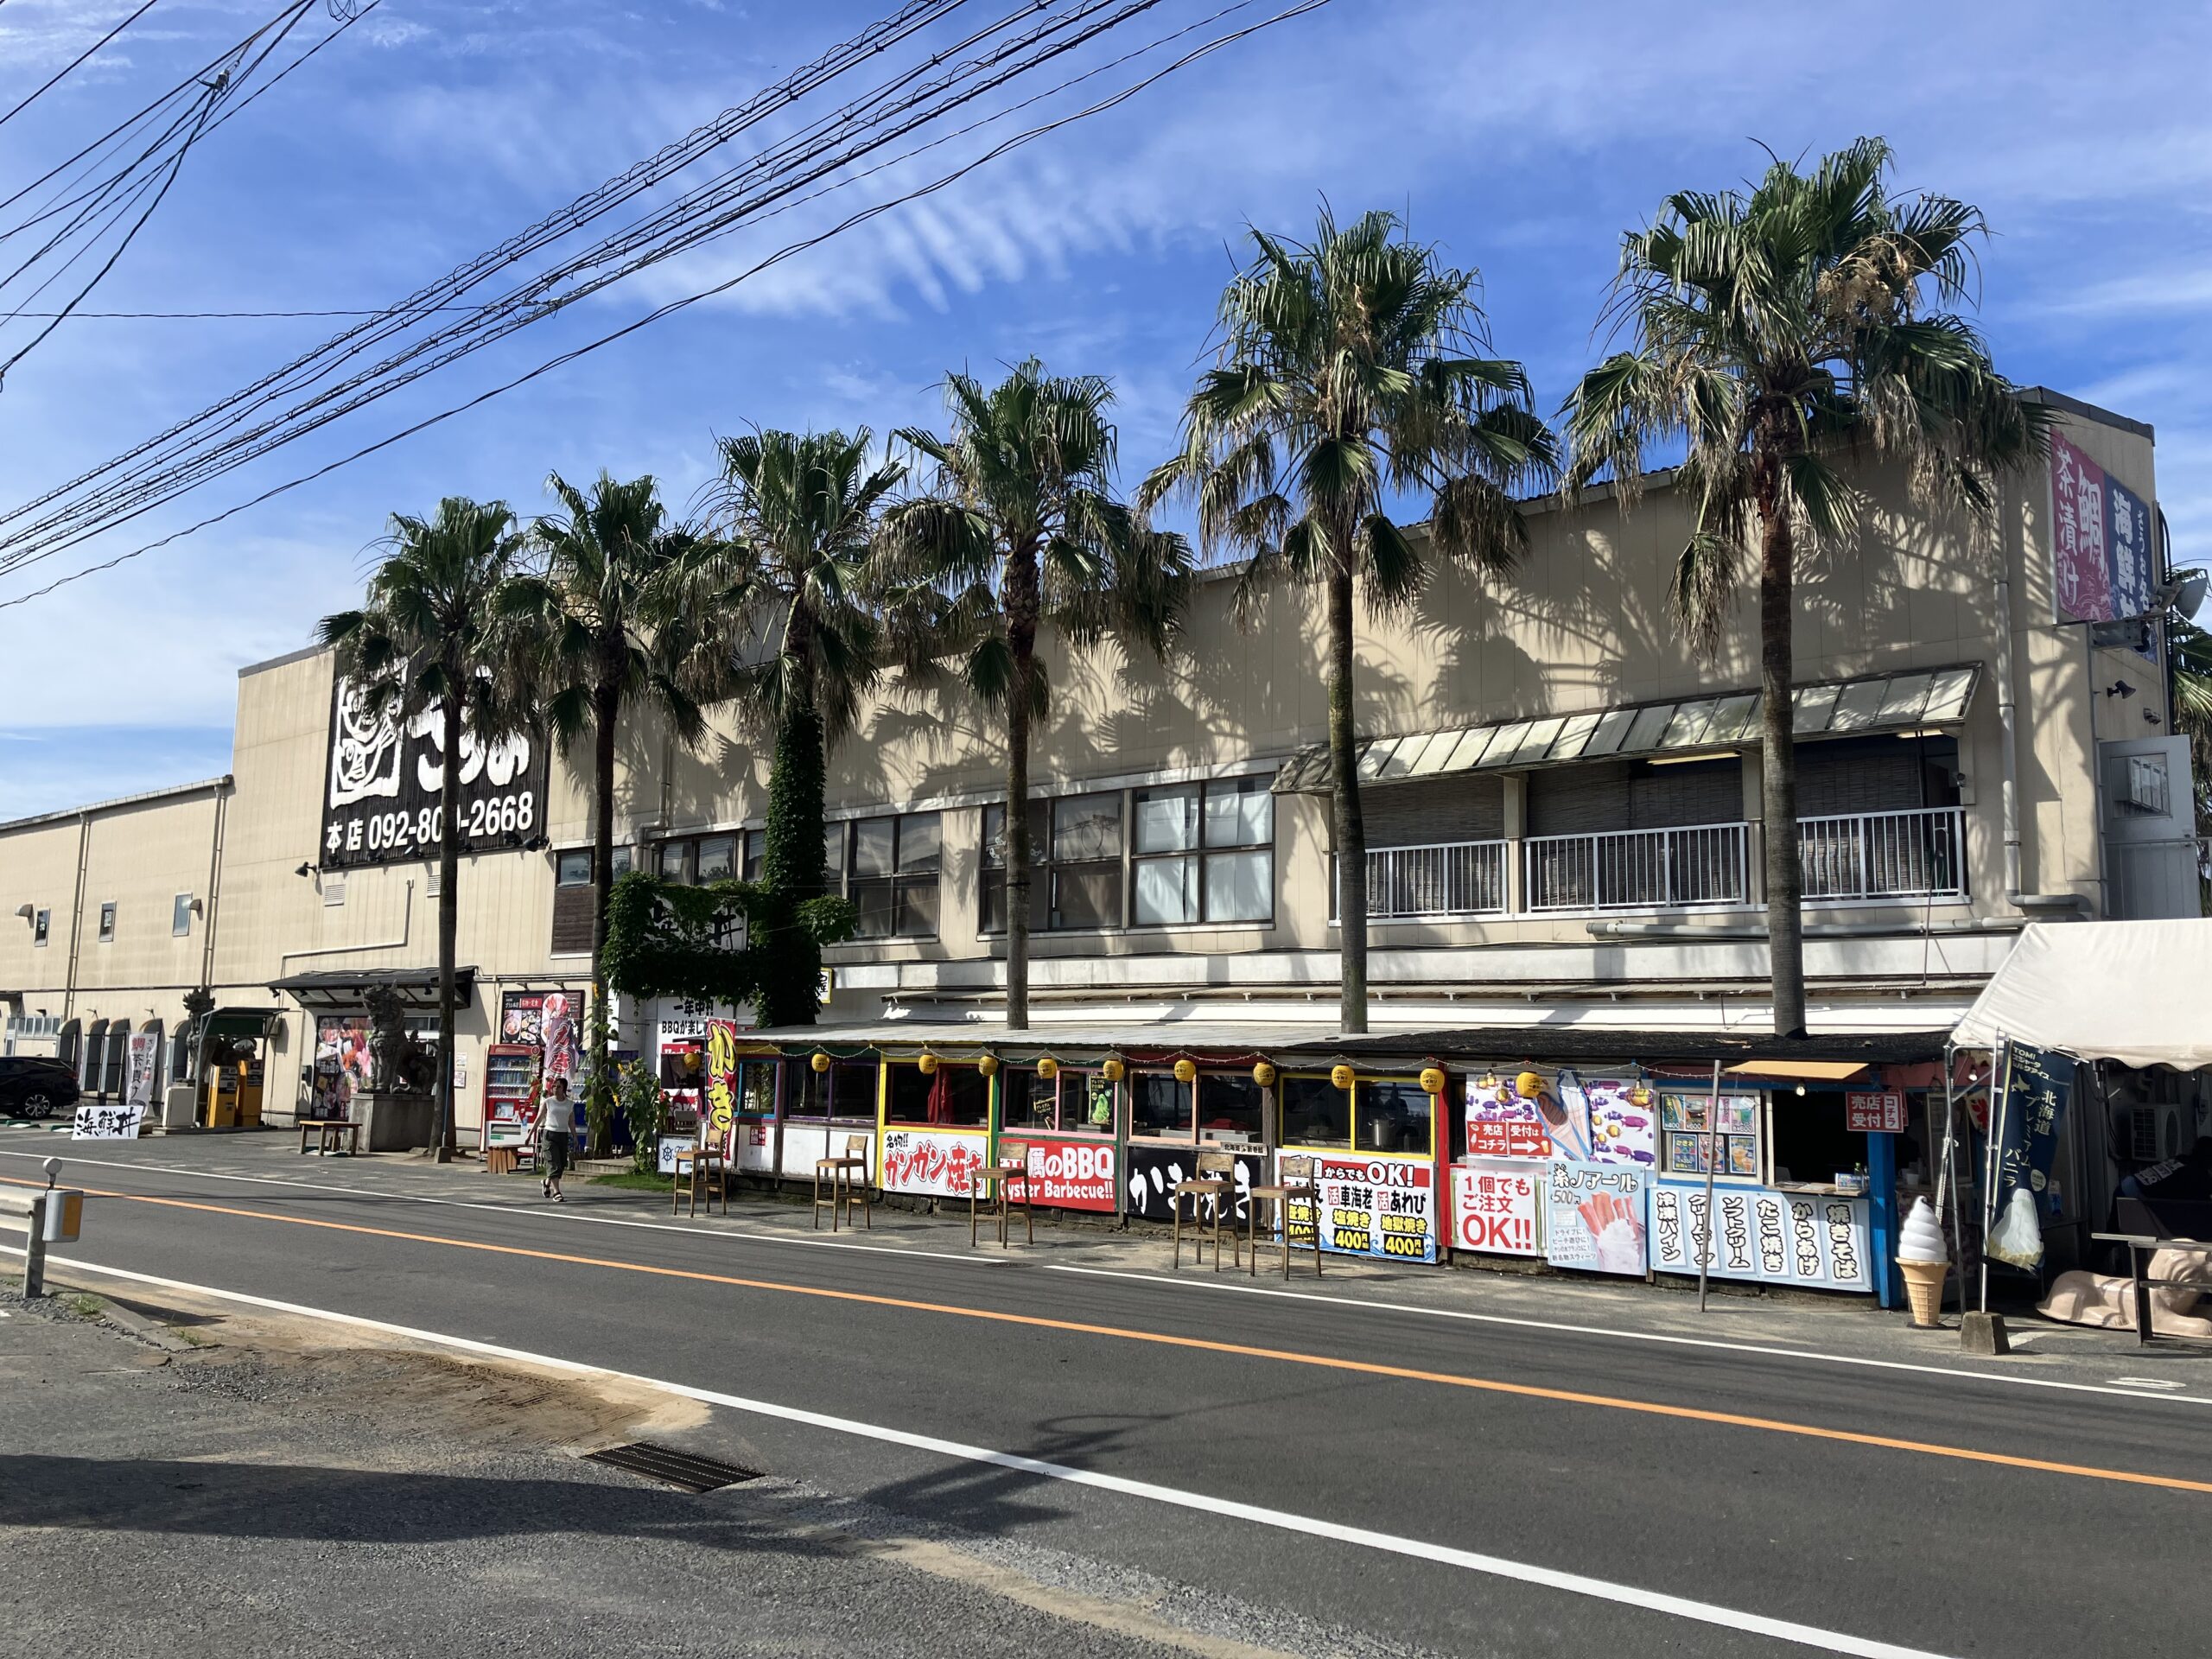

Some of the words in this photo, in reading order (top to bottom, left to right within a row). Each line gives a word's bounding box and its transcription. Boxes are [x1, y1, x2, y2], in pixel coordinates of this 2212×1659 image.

[327, 818, 364, 854] 本店
[369, 791, 533, 850] 092-80-2668
[662, 1020, 708, 1035] BBQが楽し
[1852, 1095, 1881, 1110] 売店
[1885, 1098, 1896, 1126] コチラ
[2034, 1090, 2057, 1136] 北海道
[1483, 1124, 1503, 1136] 売店
[1510, 1124, 1539, 1137] 受付は
[1852, 1112, 1882, 1128] 受付
[2020, 1095, 2040, 1166] プレミアム
[887, 1133, 908, 1148] 名物!!
[1478, 1139, 1507, 1150] コチラ
[2004, 1148, 2022, 1188] バニラ
[1045, 1179, 1114, 1199] Barbecue!!
[1464, 1176, 1530, 1197] 1個でも
[1463, 1194, 1514, 1213] ご注文
[1332, 1208, 1372, 1229] 塩焼き
[1380, 1213, 1428, 1235] 地獄焼き
[1656, 1192, 1681, 1262] 冷凍パイン
[1463, 1214, 1532, 1249] OK!!
[1722, 1197, 1751, 1268] ソフトクリーム
[1757, 1199, 1784, 1273] たこ焼き
[1791, 1202, 1820, 1276] からあげ
[1826, 1204, 1858, 1280] 焼きそば
